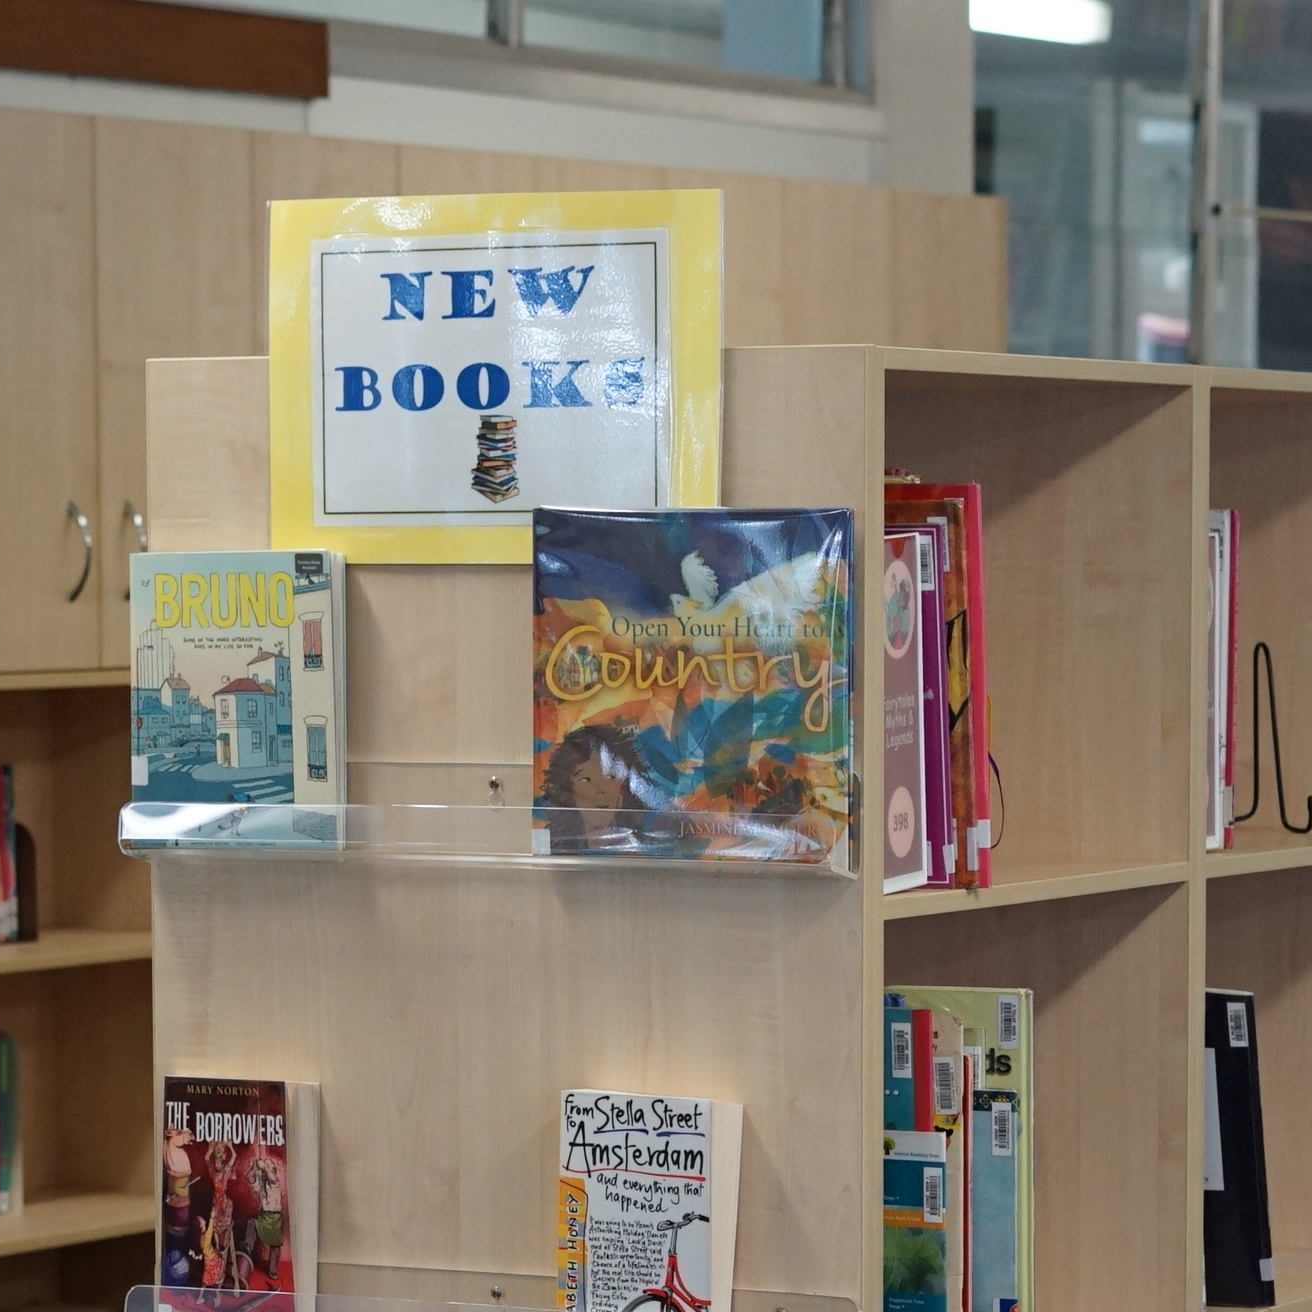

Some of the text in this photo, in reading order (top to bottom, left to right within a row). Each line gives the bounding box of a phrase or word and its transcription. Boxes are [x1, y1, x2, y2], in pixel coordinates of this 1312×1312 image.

[380, 265, 594, 321] NEW
[334, 357, 645, 412] BOOKS
[154, 571, 295, 628] BRUNO
[612, 616, 668, 643] Open
[677, 616, 725, 637] Your
[802, 620, 824, 638] to
[545, 625, 848, 733] Country
[885, 714, 907, 732] Myths
[886, 731, 914, 750] Legends
[893, 813, 909, 832] 398
[186, 1084, 260, 1097] MARY NORTON
[166, 1101, 190, 1132] THE
[195, 1112, 285, 1146] BORROWERS
[567, 1114, 577, 1132] to
[594, 1096, 647, 1131] Stella
[652, 1099, 703, 1131] Street
[566, 1121, 704, 1178] Amsterdam
[597, 1173, 704, 1205] and everything that
[605, 1185, 668, 1212] happened
[567, 1193, 579, 1251] HONEY
[606, 1220, 620, 1229] going
[591, 1300, 619, 1312] ordinary
